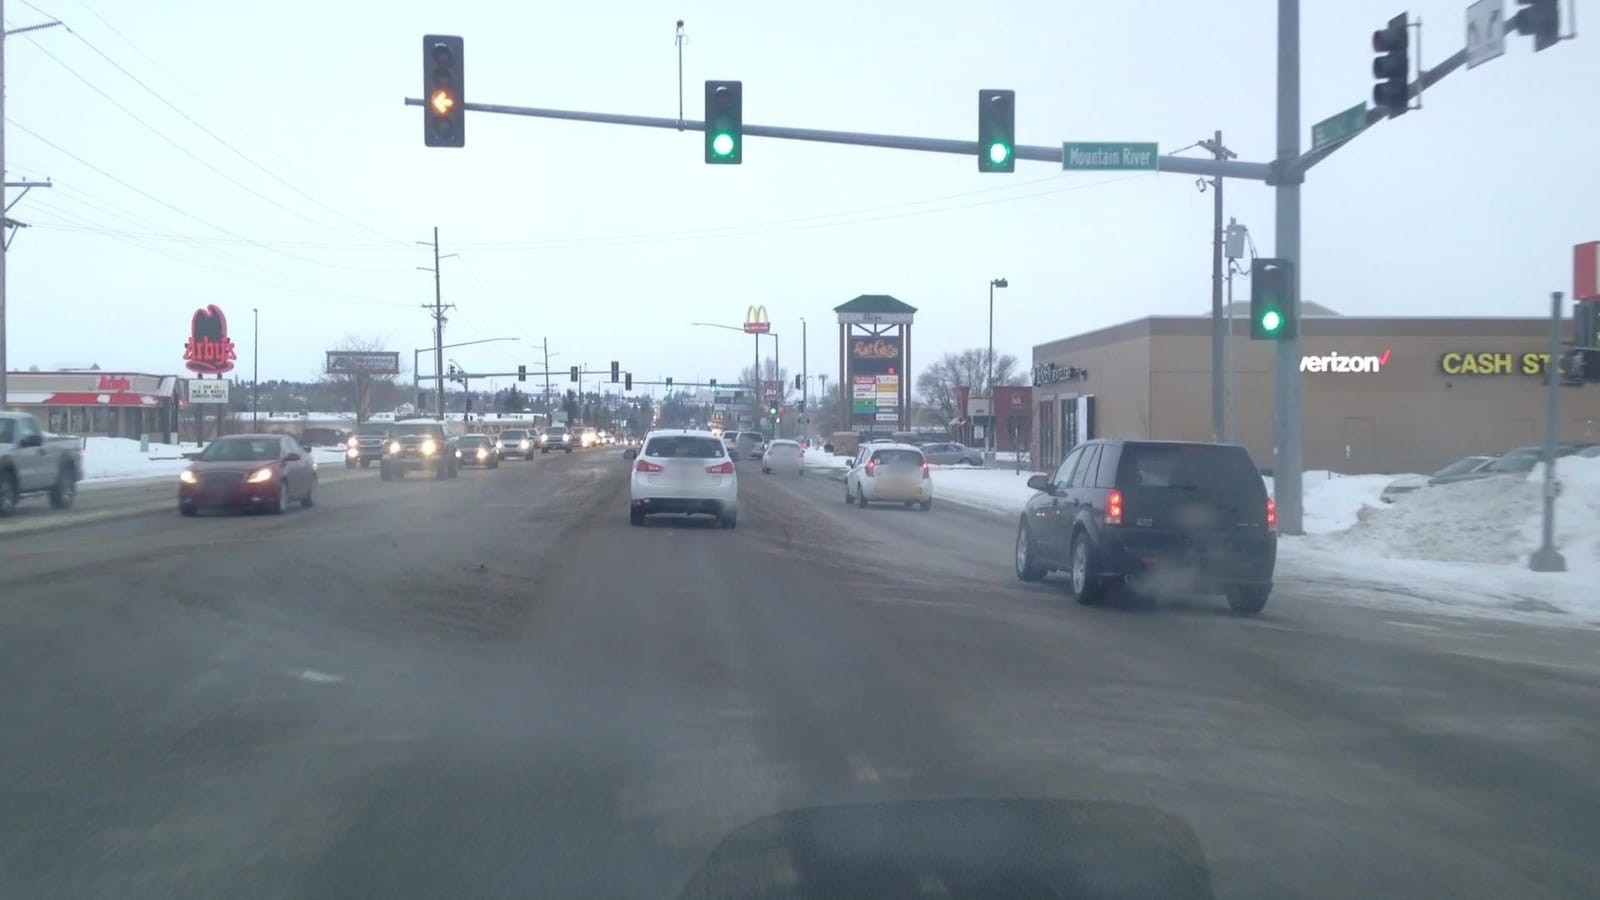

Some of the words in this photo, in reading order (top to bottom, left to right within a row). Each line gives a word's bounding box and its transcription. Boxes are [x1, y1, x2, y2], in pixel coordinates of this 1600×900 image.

[1069, 147, 1120, 166] Mountain
[1122, 147, 1151, 166] River
[1442, 352, 1512, 375] CASH
